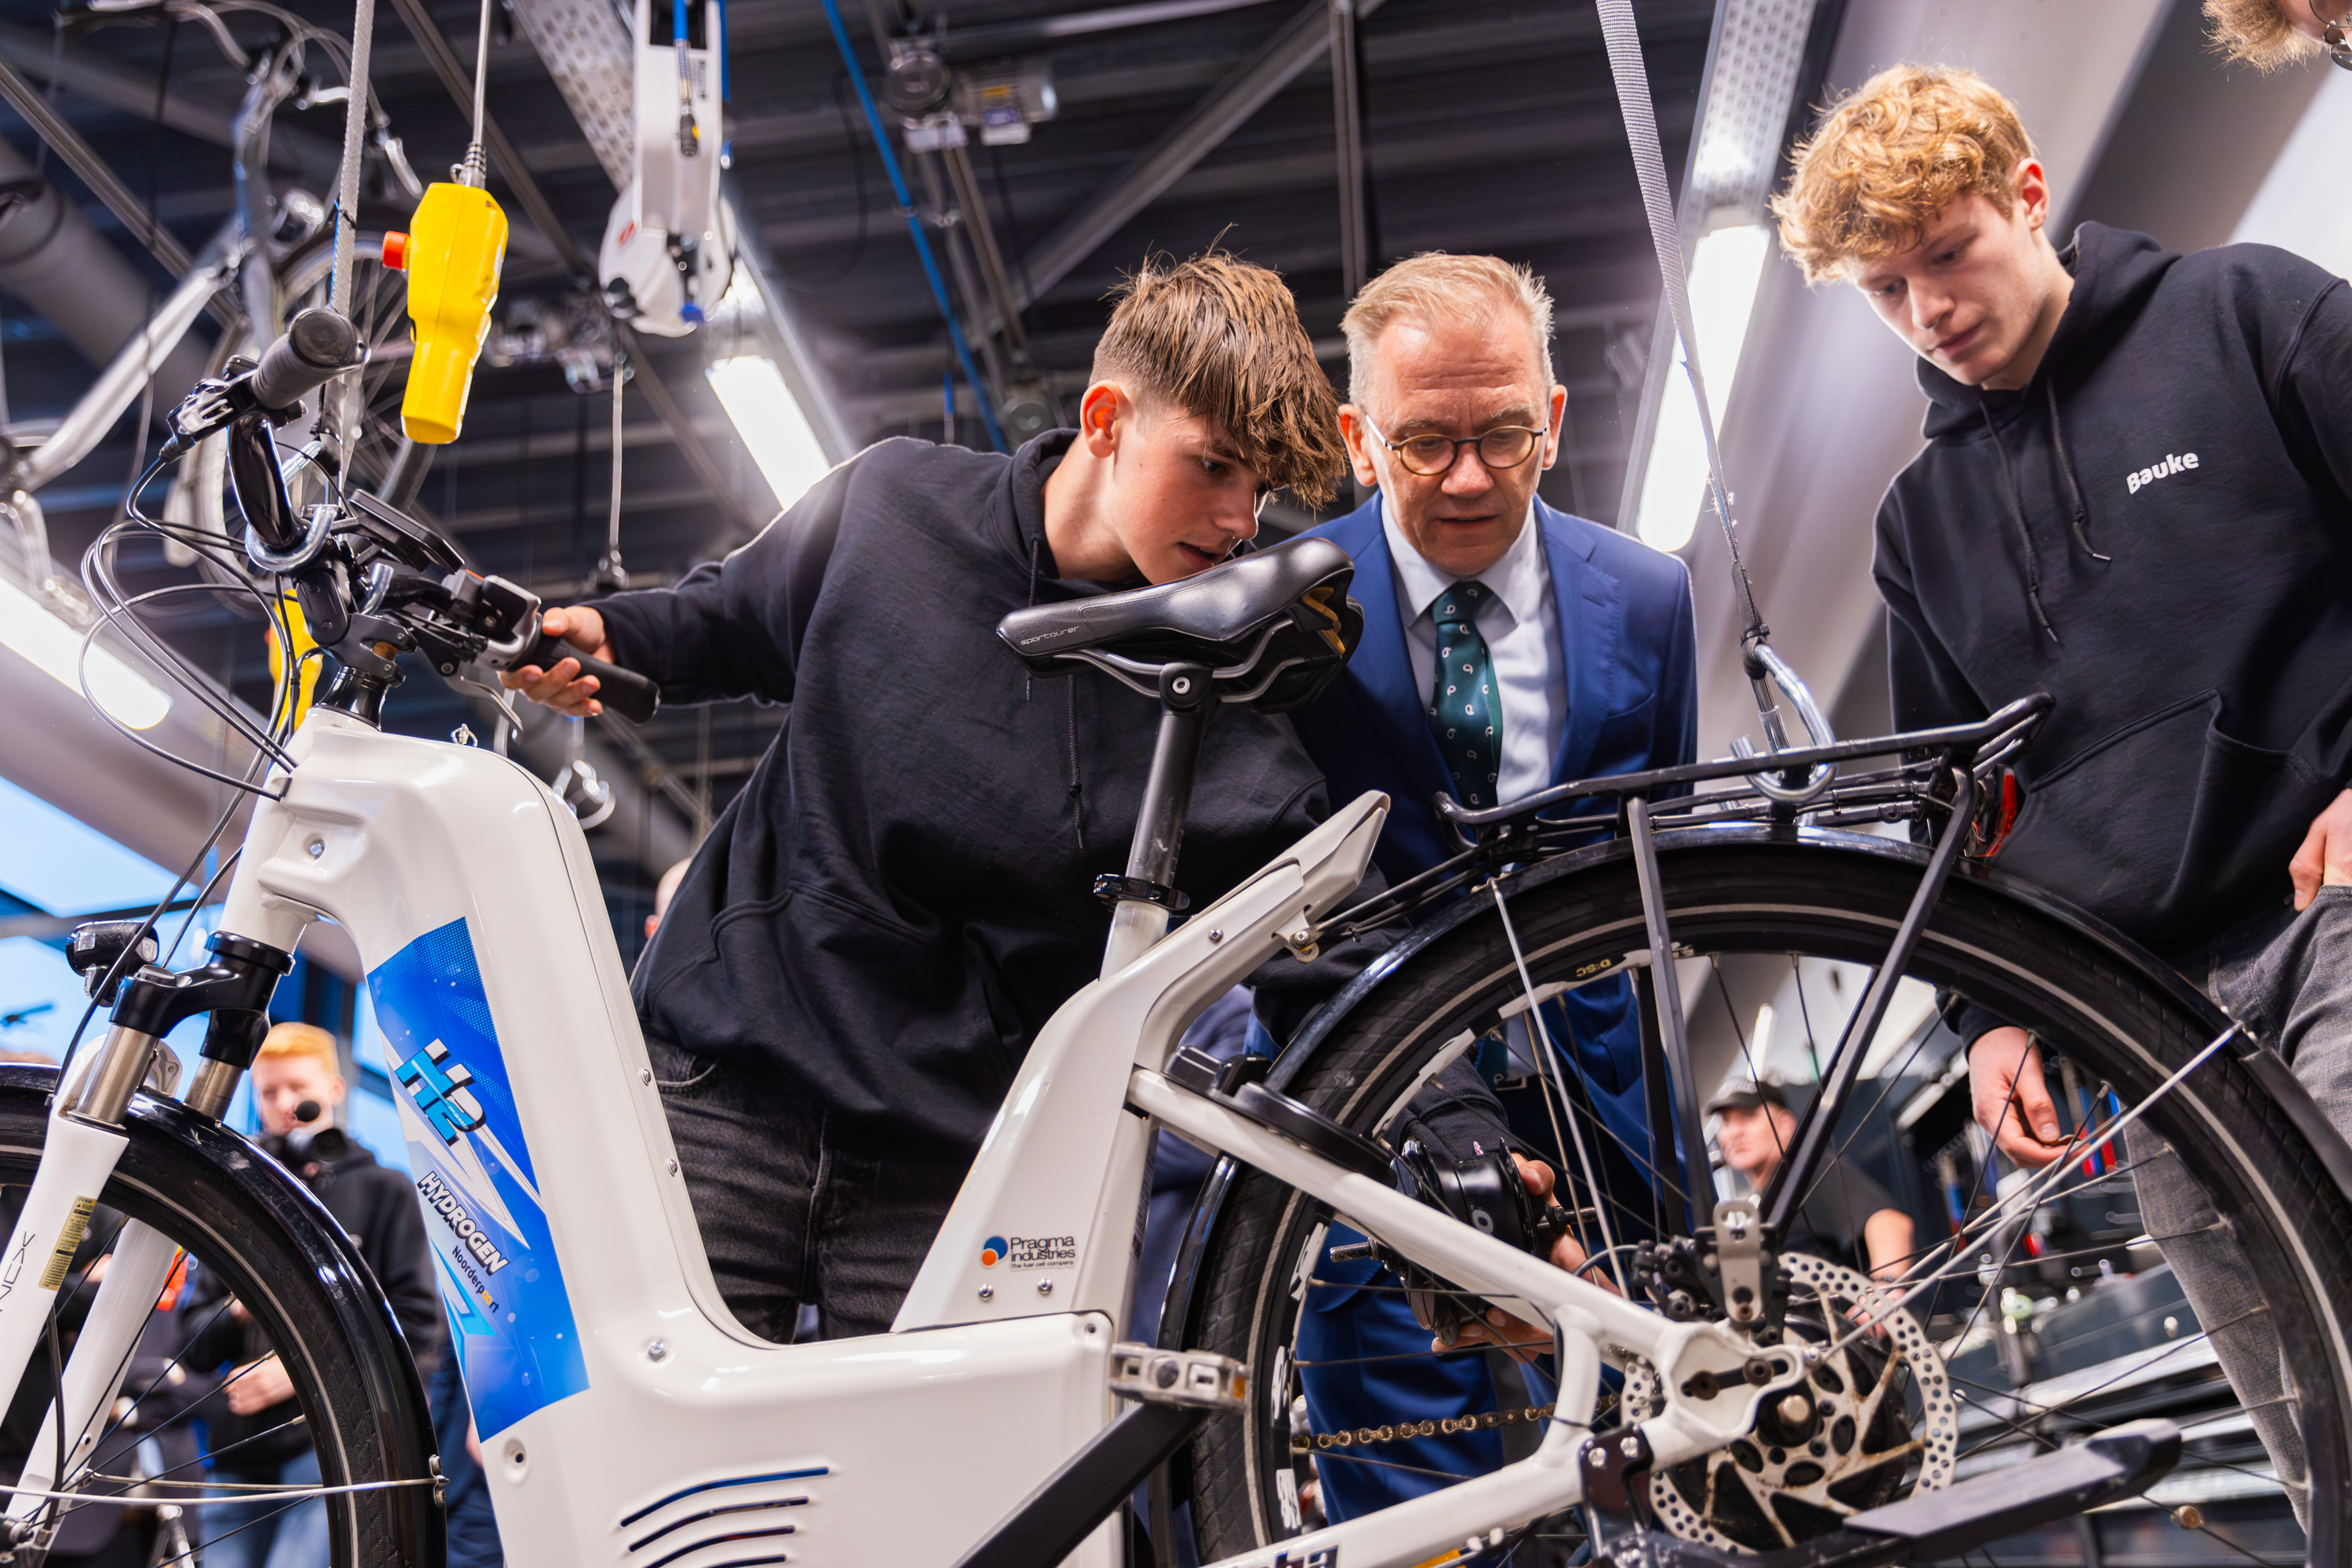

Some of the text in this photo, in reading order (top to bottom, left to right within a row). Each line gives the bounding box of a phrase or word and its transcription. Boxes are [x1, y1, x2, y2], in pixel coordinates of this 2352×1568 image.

[2126, 452, 2199, 495] Bauke
[1020, 626, 1080, 646] sportourer
[394, 1037, 487, 1147] H2
[417, 1171, 510, 1276] HYDROGEN
[1010, 1236, 1075, 1252] Pragma
[1011, 1247, 1076, 1262] industries
[452, 1245, 499, 1313] Noorderpoort
